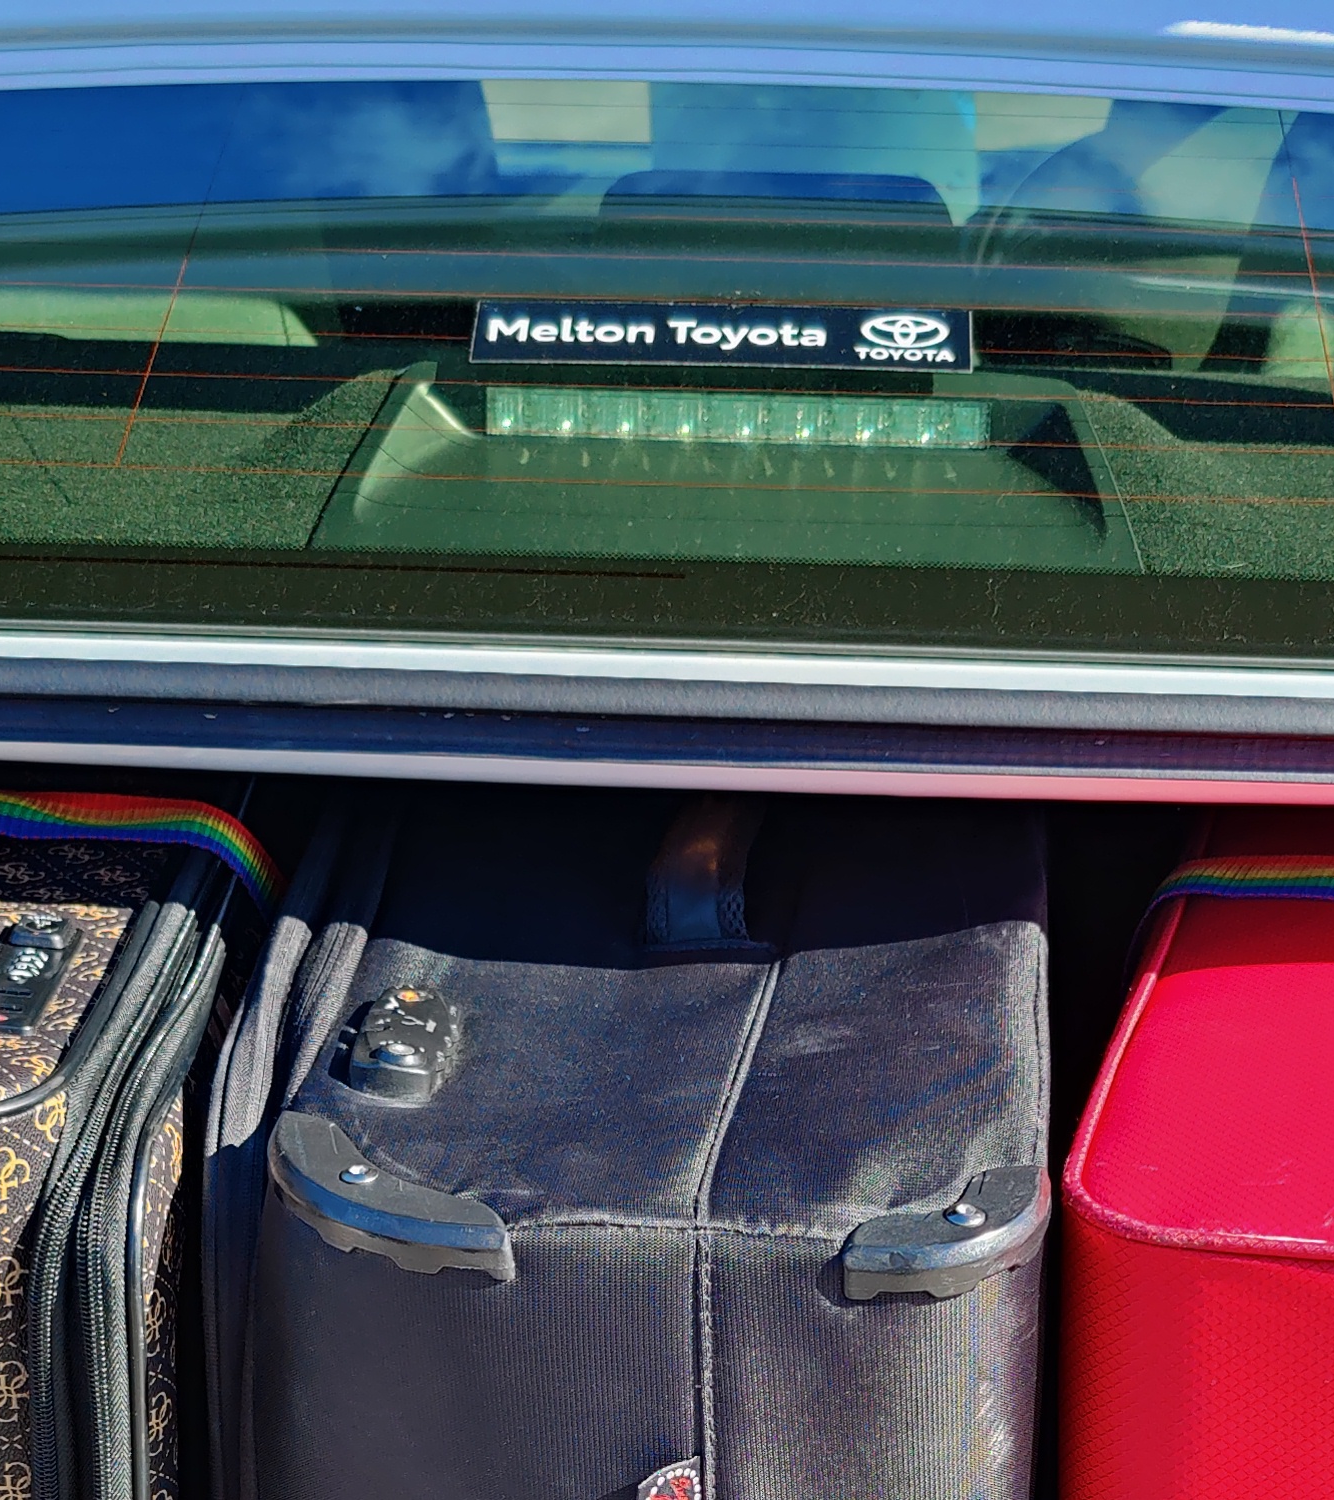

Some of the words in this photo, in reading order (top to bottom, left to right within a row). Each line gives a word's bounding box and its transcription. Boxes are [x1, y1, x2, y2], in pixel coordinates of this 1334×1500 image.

[486, 311, 655, 344] Melton
[668, 318, 828, 351] Toyota
[854, 347, 956, 363] TOYOTA
